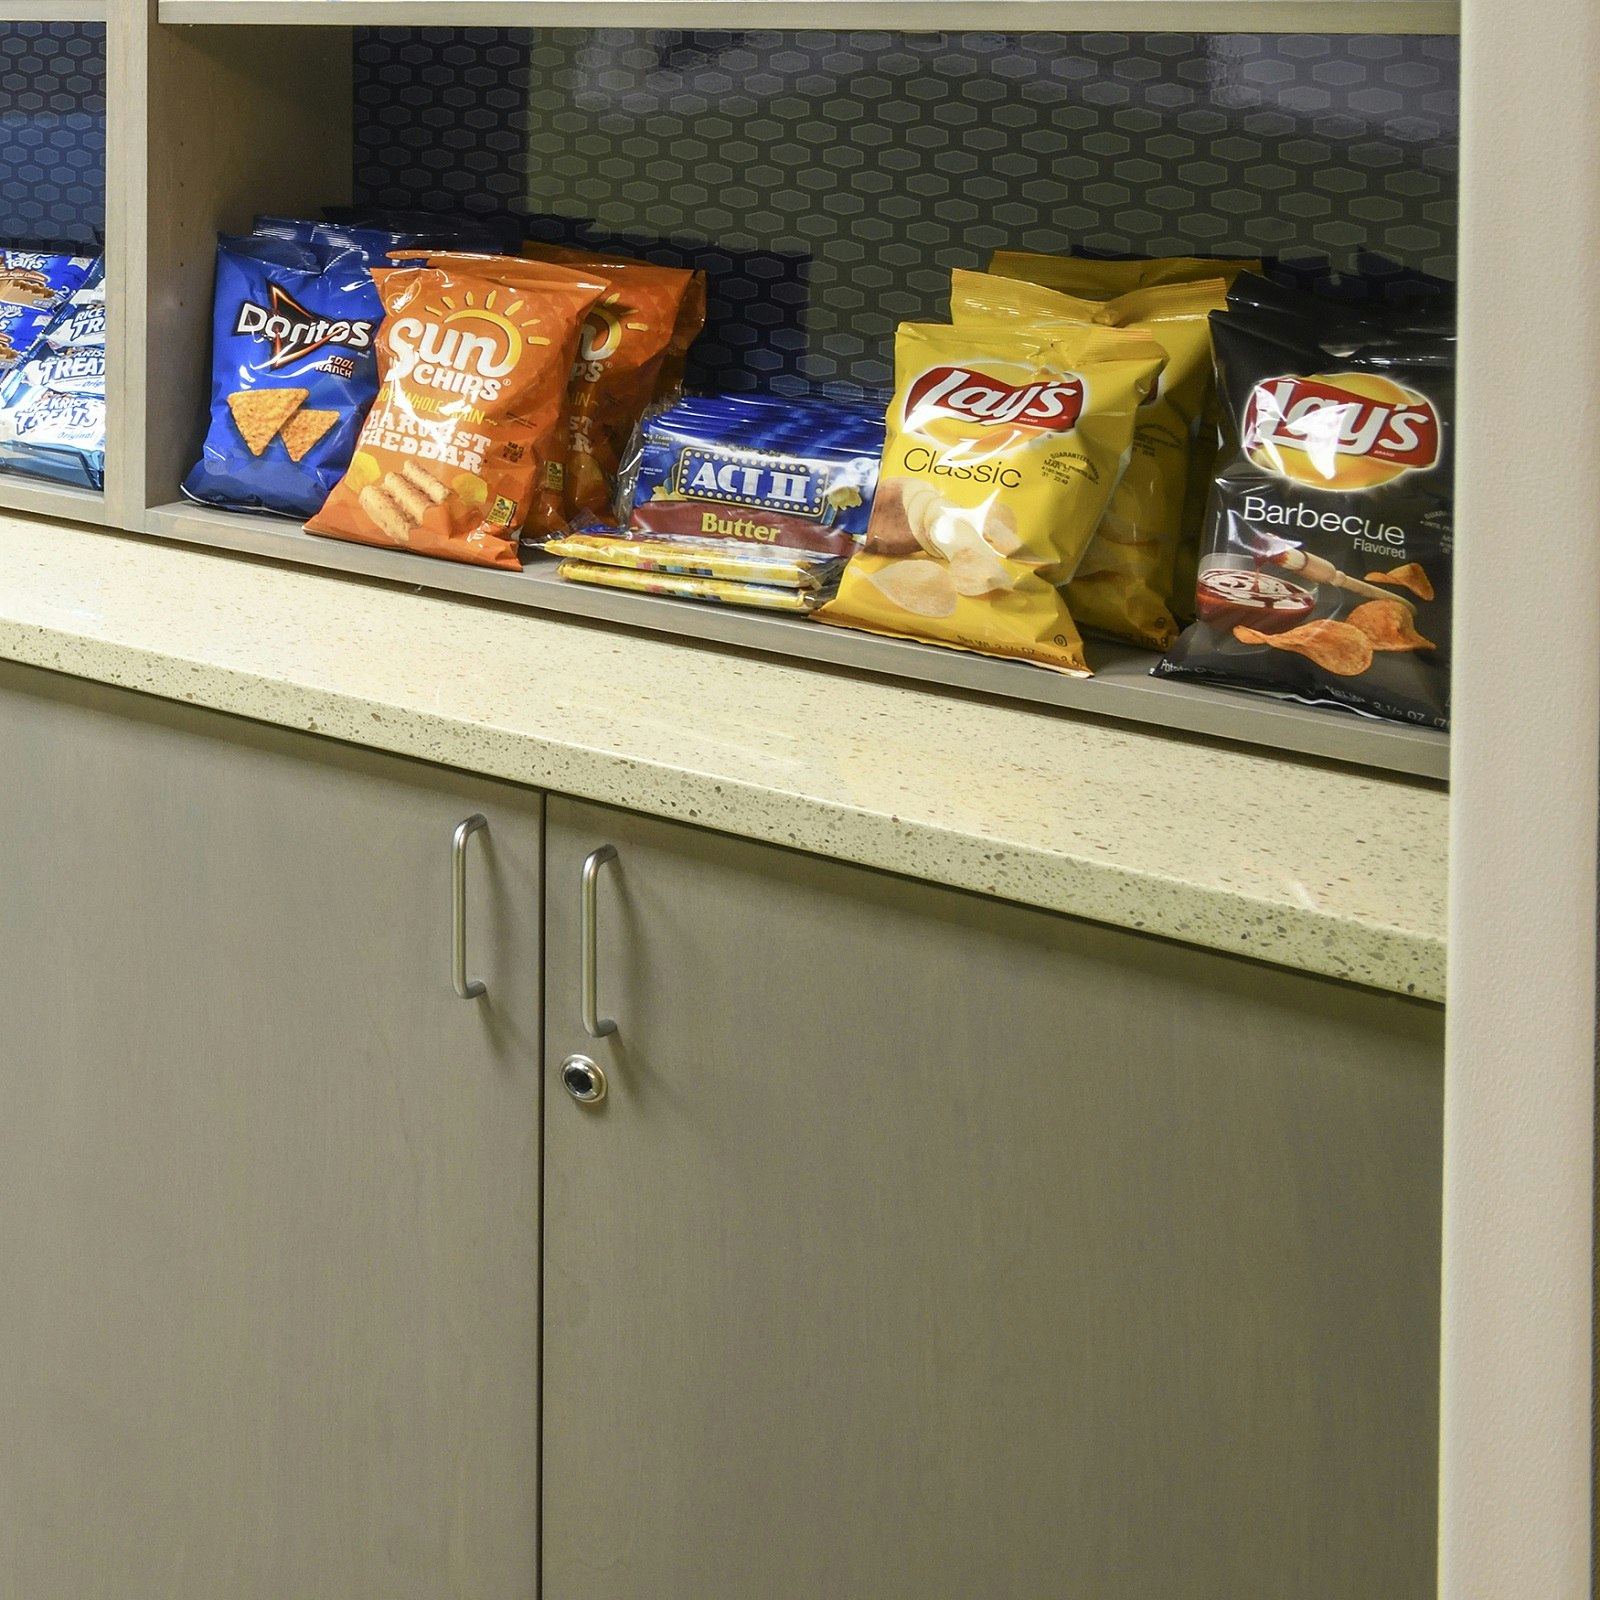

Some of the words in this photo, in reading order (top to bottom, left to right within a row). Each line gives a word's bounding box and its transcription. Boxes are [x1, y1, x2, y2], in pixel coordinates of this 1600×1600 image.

[240, 302, 375, 347] Doritos
[315, 363, 353, 379] RANCH
[328, 355, 355, 368] COOL
[412, 363, 502, 402] CHIPS
[903, 369, 1079, 432] Lay's
[1252, 380, 1430, 457] Lay's
[688, 461, 765, 498] ACT
[767, 473, 811, 504] II
[903, 447, 1022, 489] Classic
[701, 512, 782, 544] Butter
[1243, 495, 1406, 546] Barbecue
[1353, 537, 1407, 560] Flavored
